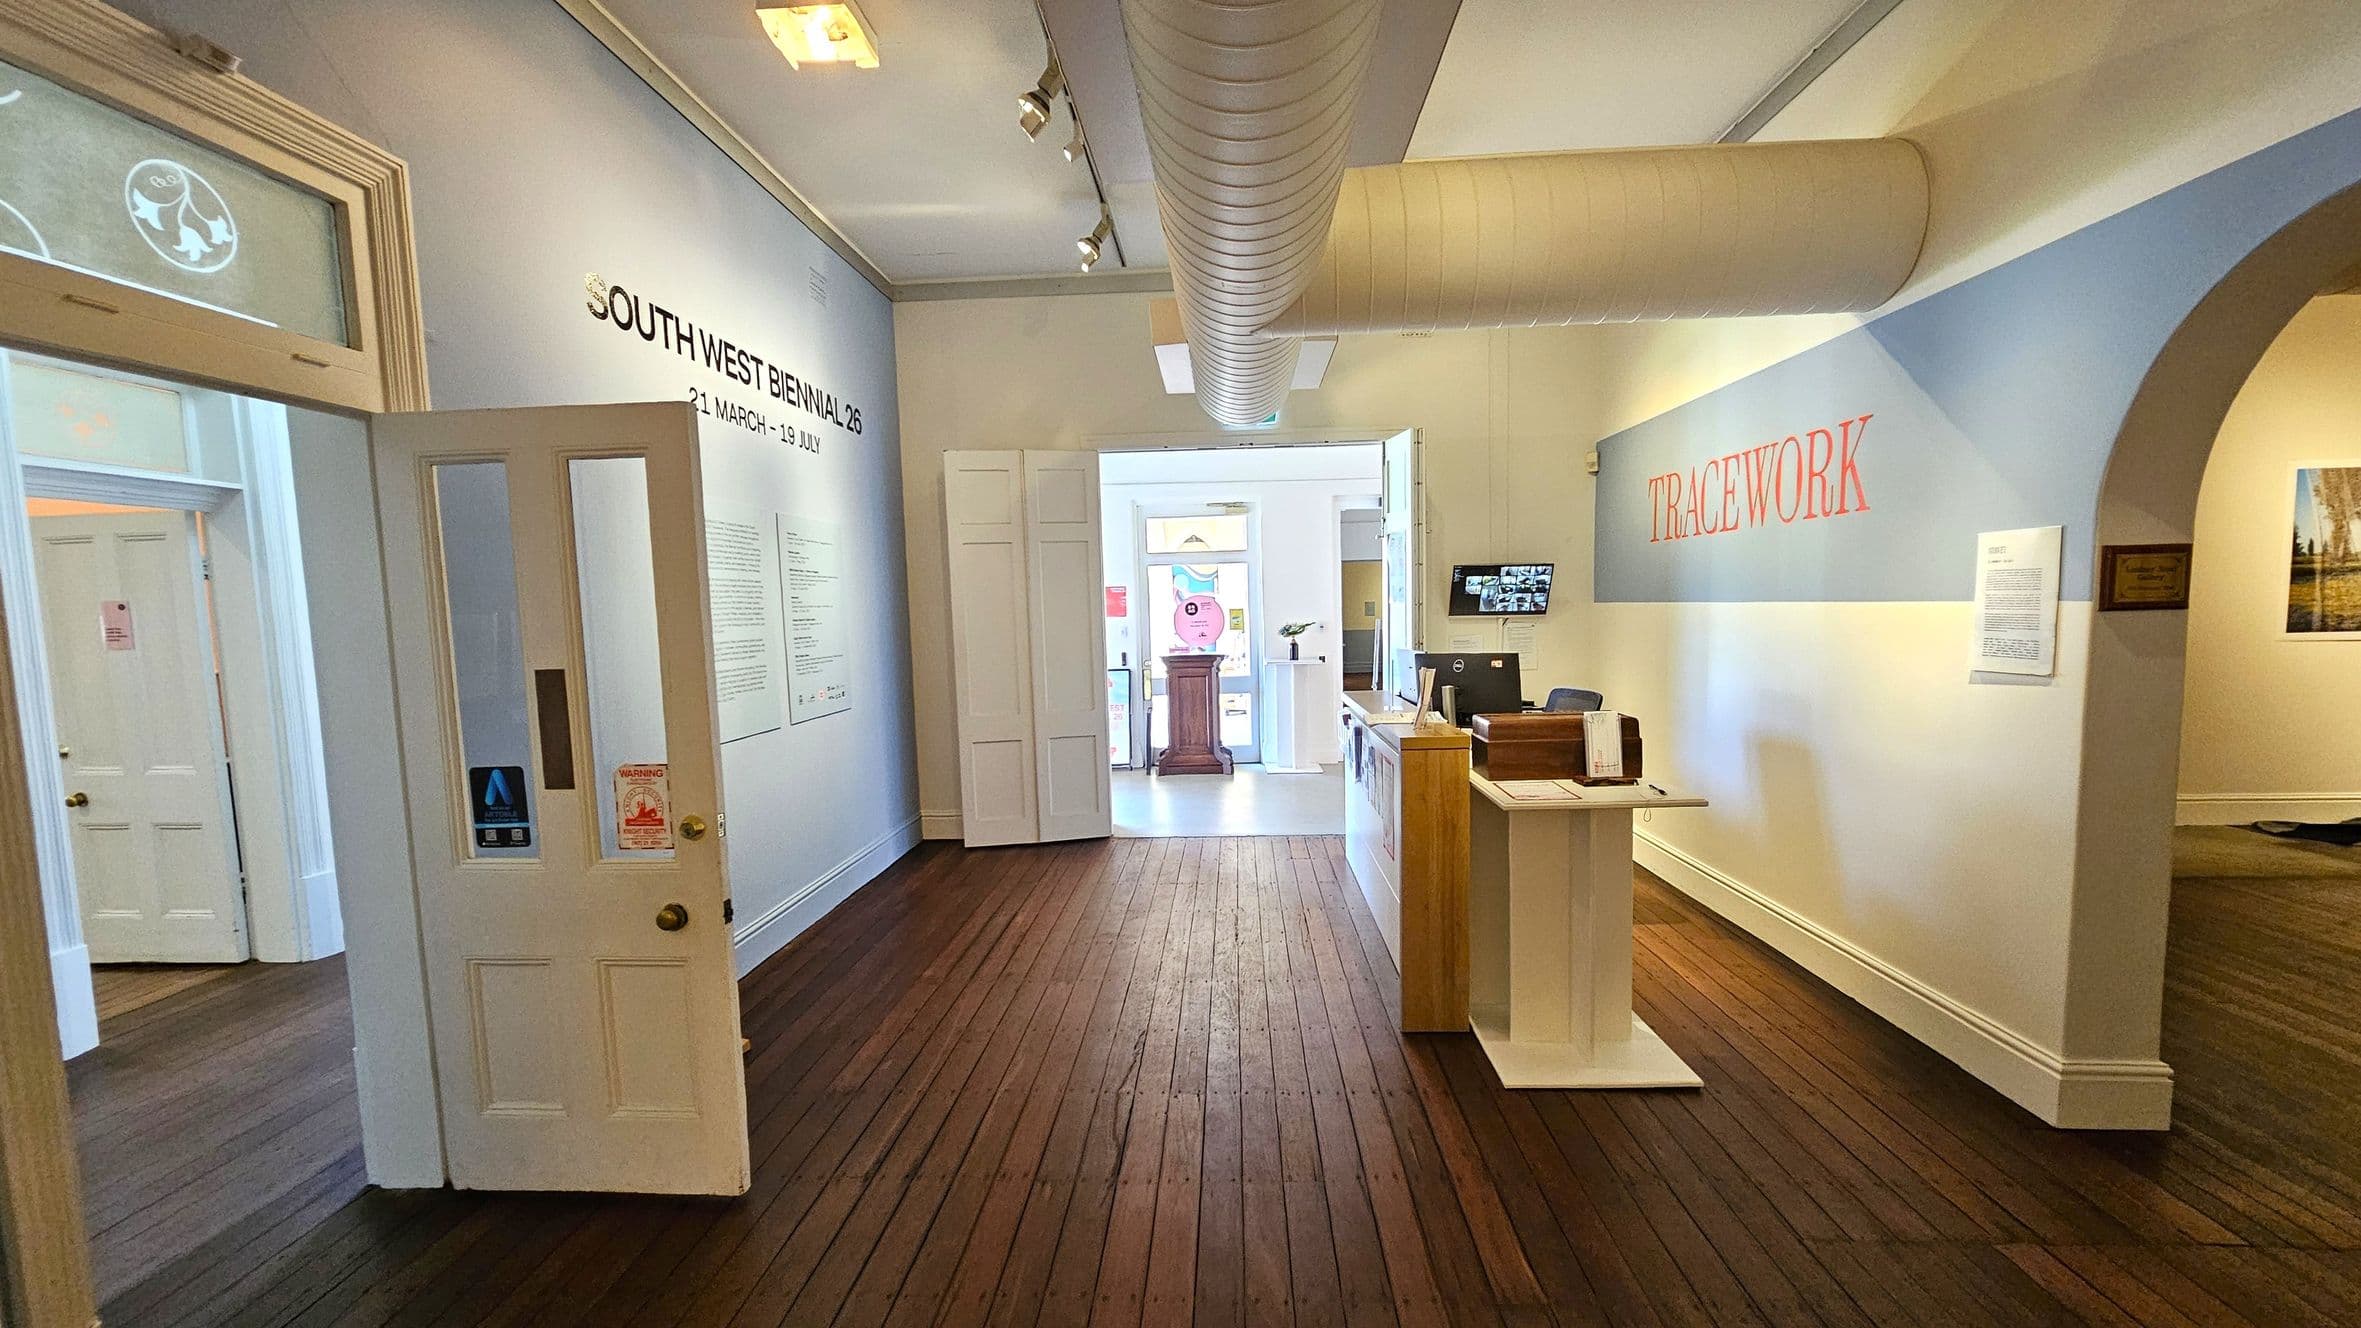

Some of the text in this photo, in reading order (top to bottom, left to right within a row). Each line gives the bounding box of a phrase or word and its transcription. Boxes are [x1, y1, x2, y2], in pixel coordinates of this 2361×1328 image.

[584, 272, 862, 435] SOUTH WEST BIENNIAL 26
[689, 387, 711, 415] 21
[715, 397, 766, 435] MARCH
[780, 424, 795, 445] 19
[799, 430, 821, 454] JULY
[1648, 414, 1873, 542] TRACEWORK
[619, 769, 664, 778] WARNING
